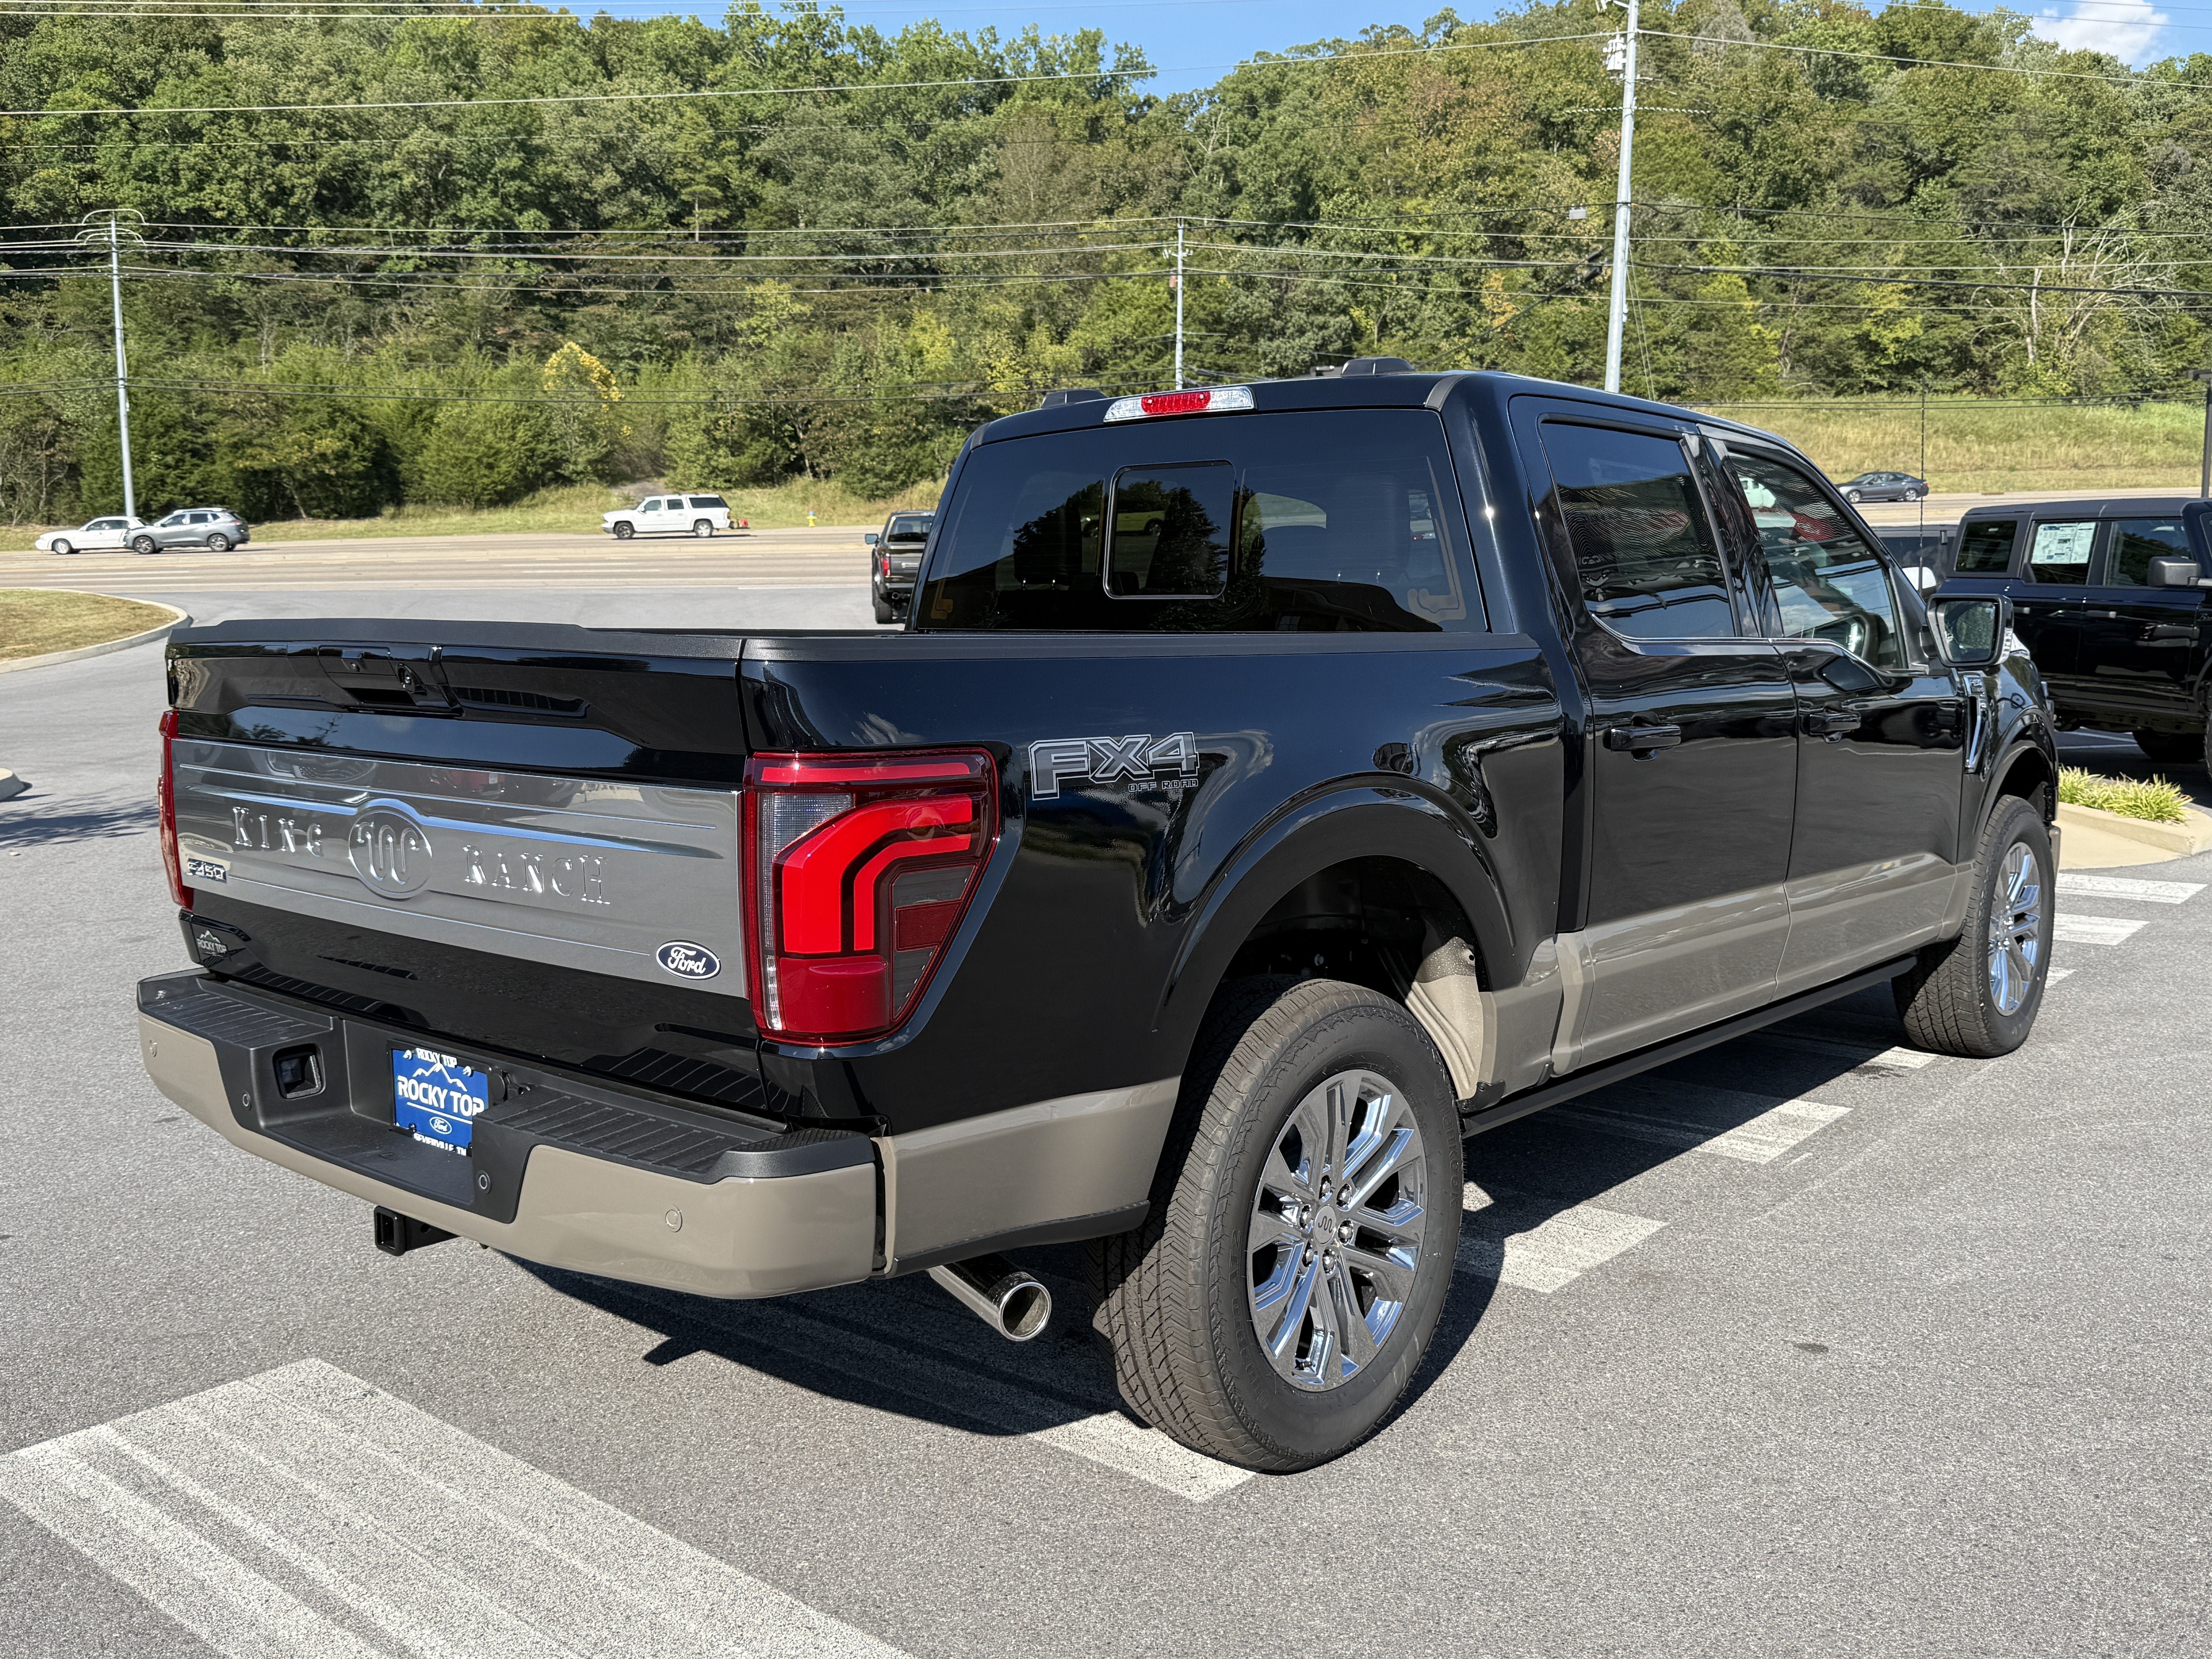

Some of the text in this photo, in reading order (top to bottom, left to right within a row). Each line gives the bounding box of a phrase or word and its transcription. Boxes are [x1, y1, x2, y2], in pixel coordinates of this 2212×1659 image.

[1028, 732, 1200, 800] FX4
[1128, 778, 1199, 792] OFF ROAD
[232, 806, 611, 905] KING RANCH
[196, 938, 227, 953] ROCKY TOP
[668, 946, 707, 974] Ford
[416, 1047, 458, 1068] ROCKY TOP
[397, 1075, 484, 1116] ROCKY TOP
[434, 1118, 448, 1132] Ford
[456, 1146, 467, 1156] TN
